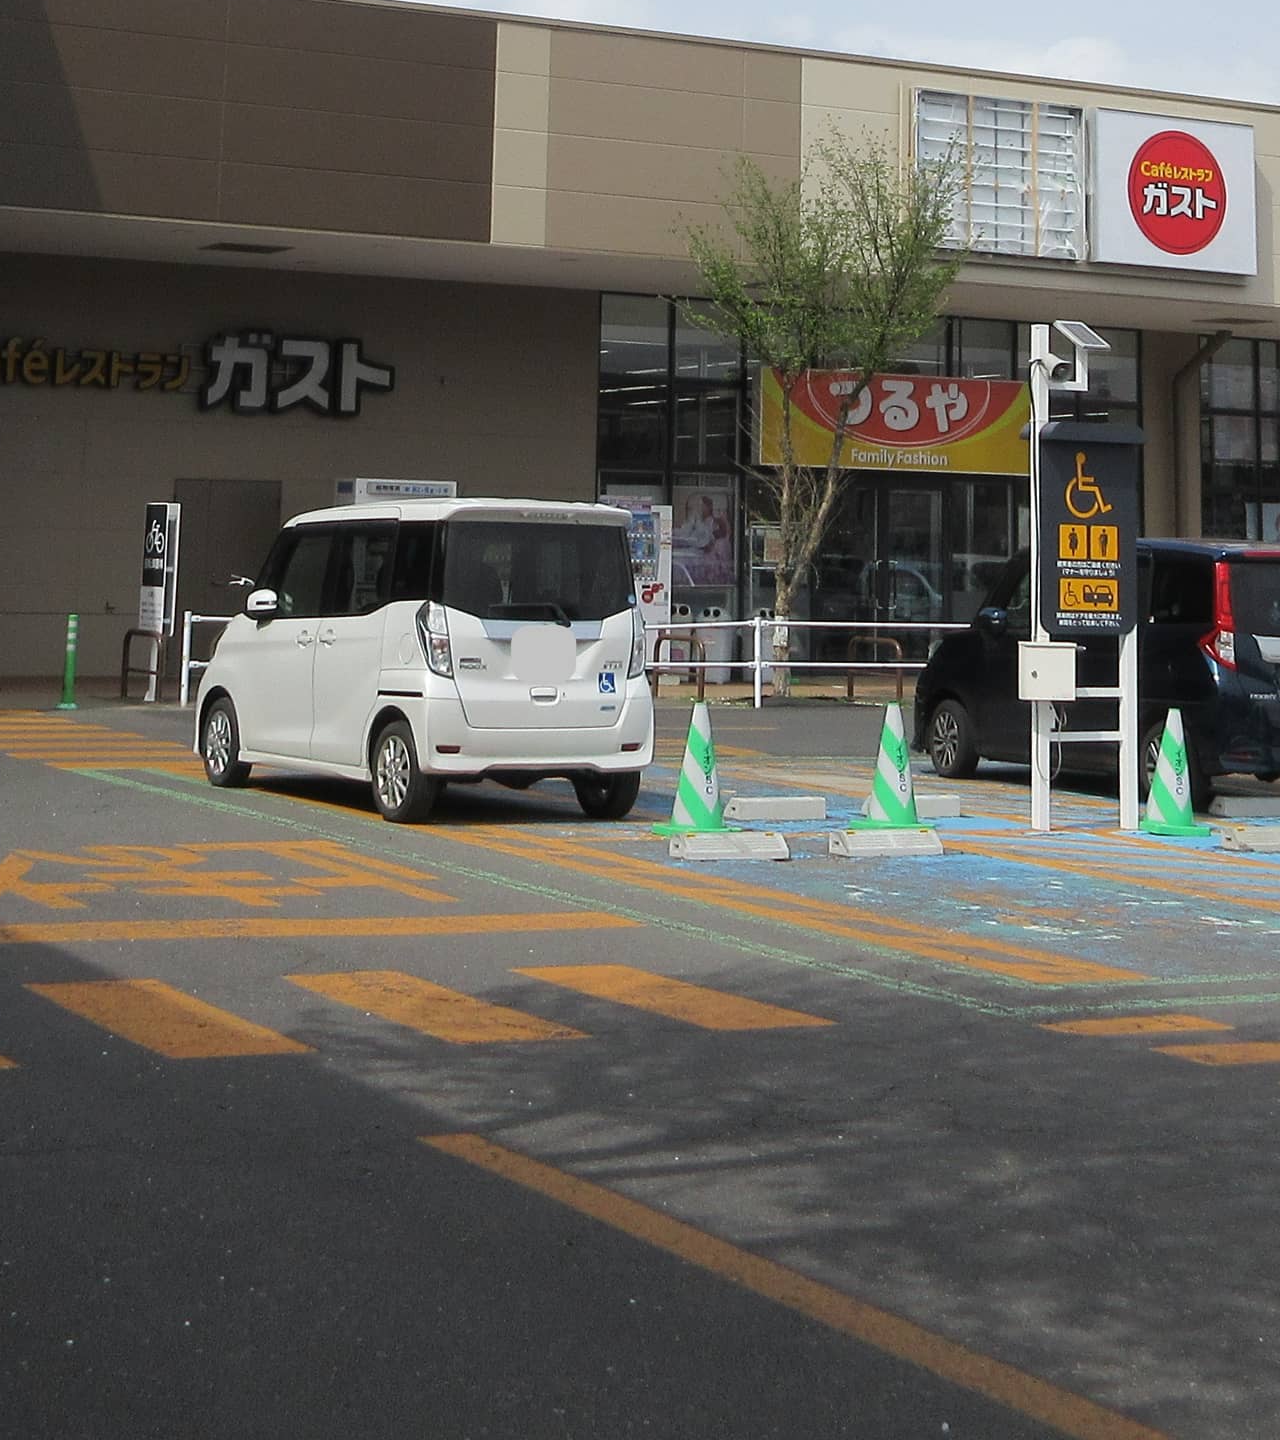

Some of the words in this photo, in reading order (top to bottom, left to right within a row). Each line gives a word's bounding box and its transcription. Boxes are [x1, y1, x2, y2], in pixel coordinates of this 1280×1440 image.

[1143, 182, 1217, 220] ガスト
[206, 332, 393, 413] ガスト
[829, 379, 968, 433] つるや
[851, 448, 895, 468] Family
[897, 450, 948, 466] Fashion
